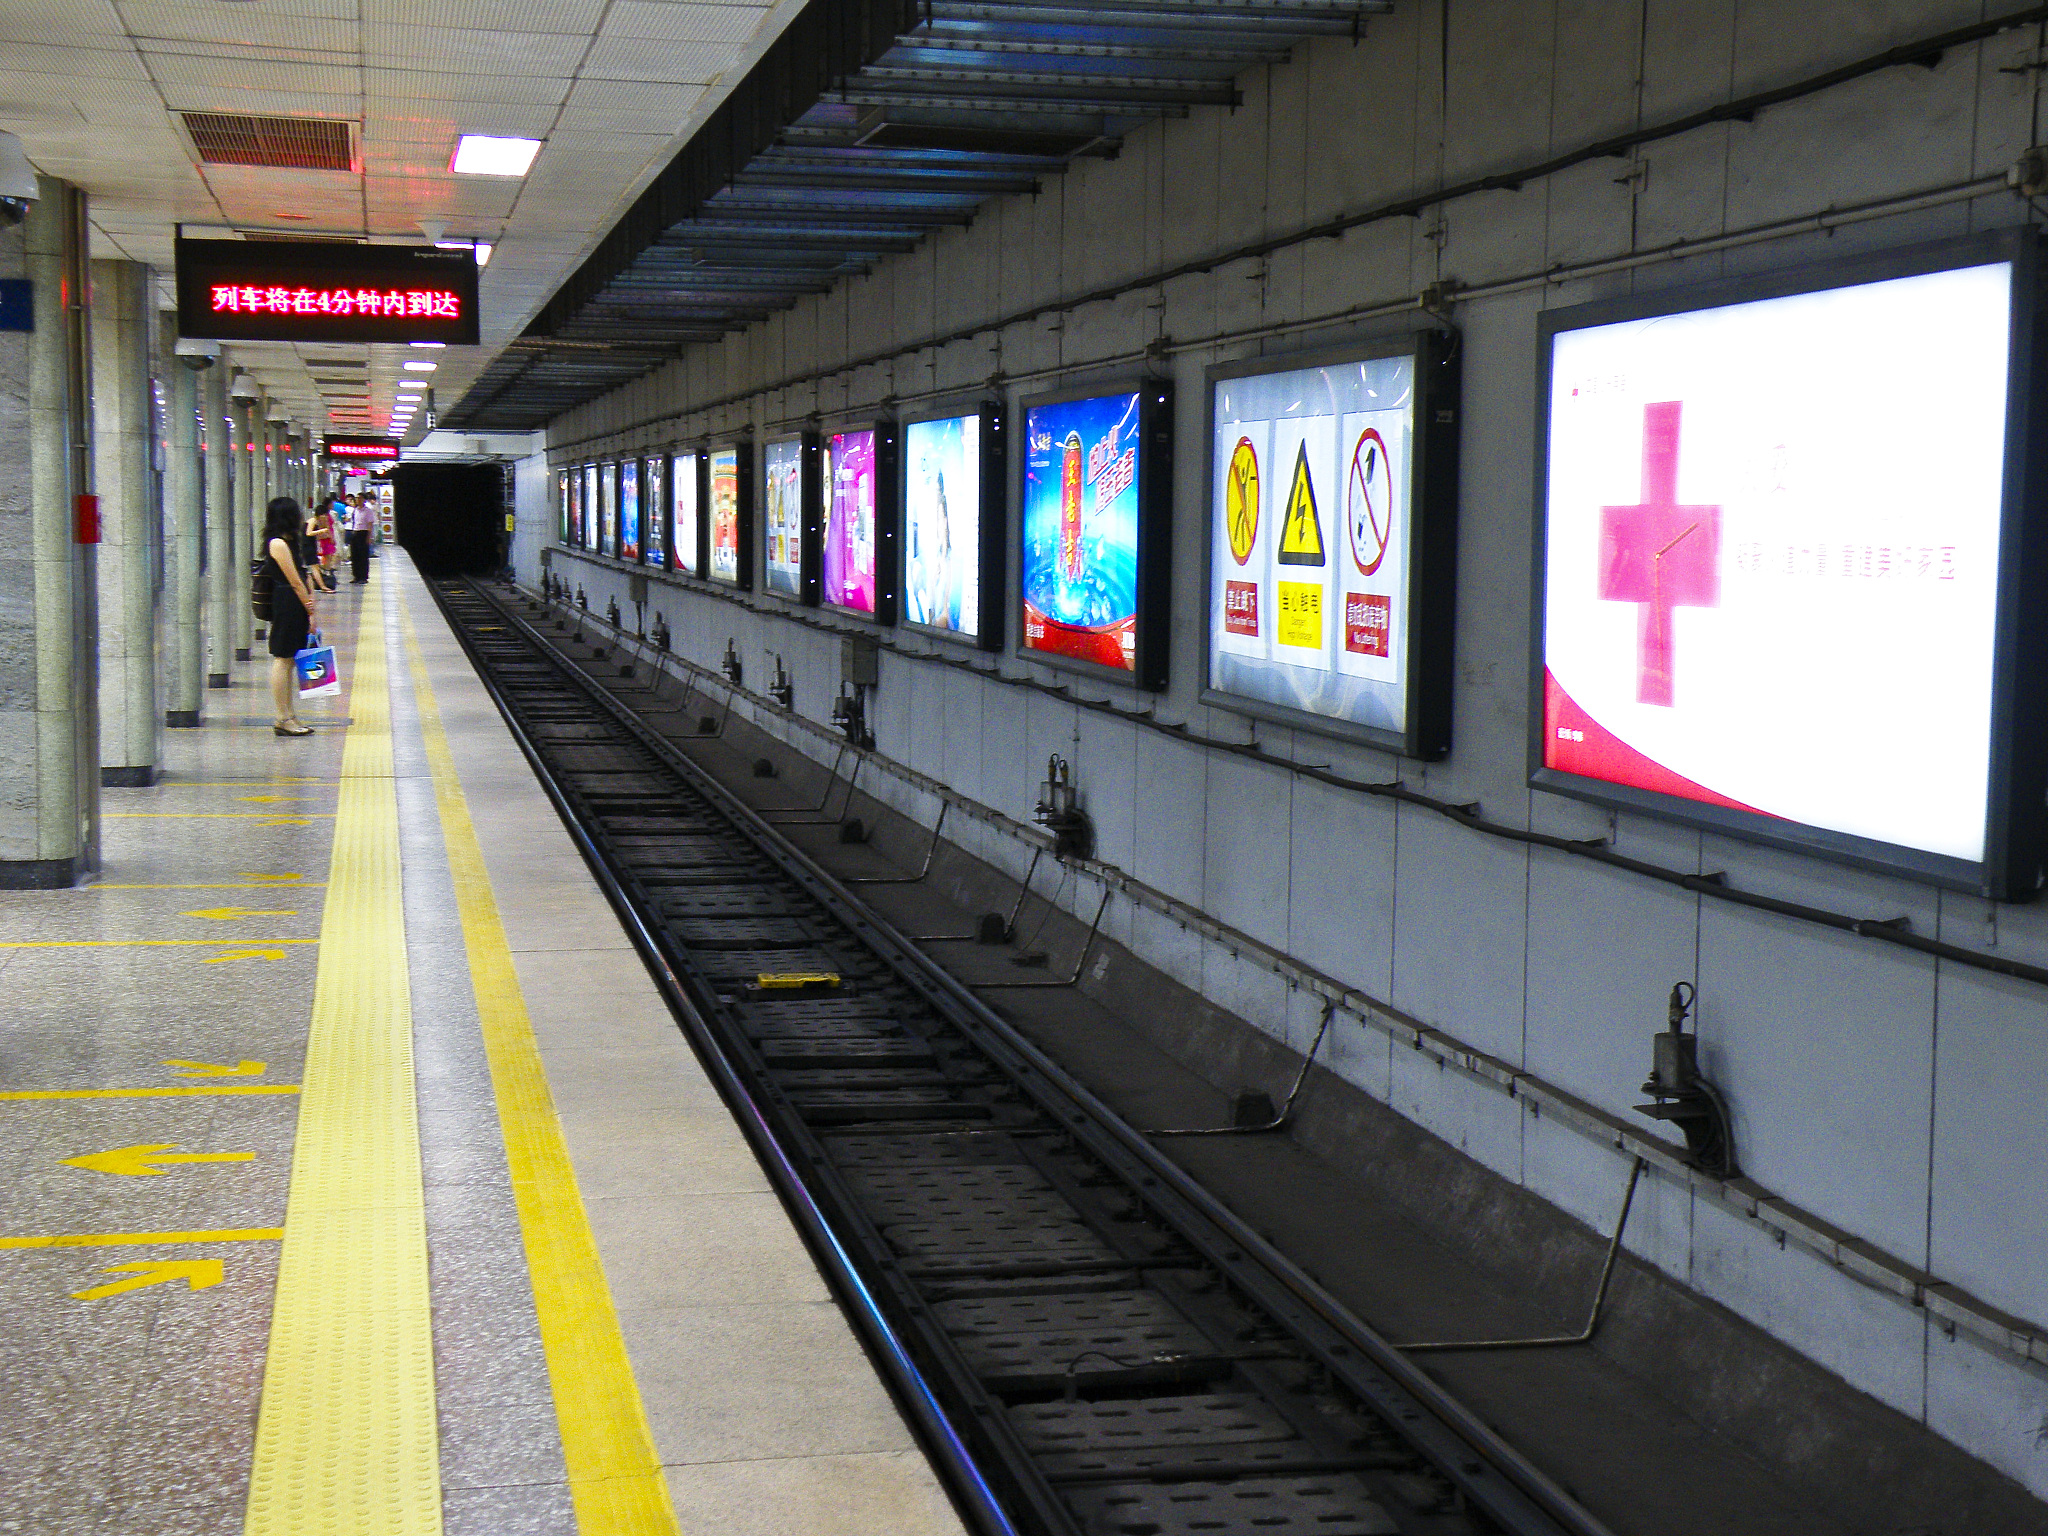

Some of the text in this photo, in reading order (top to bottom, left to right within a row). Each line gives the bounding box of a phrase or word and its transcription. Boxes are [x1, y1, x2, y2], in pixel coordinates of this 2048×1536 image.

[210, 285, 460, 318] 列车将在4分钟内到达
